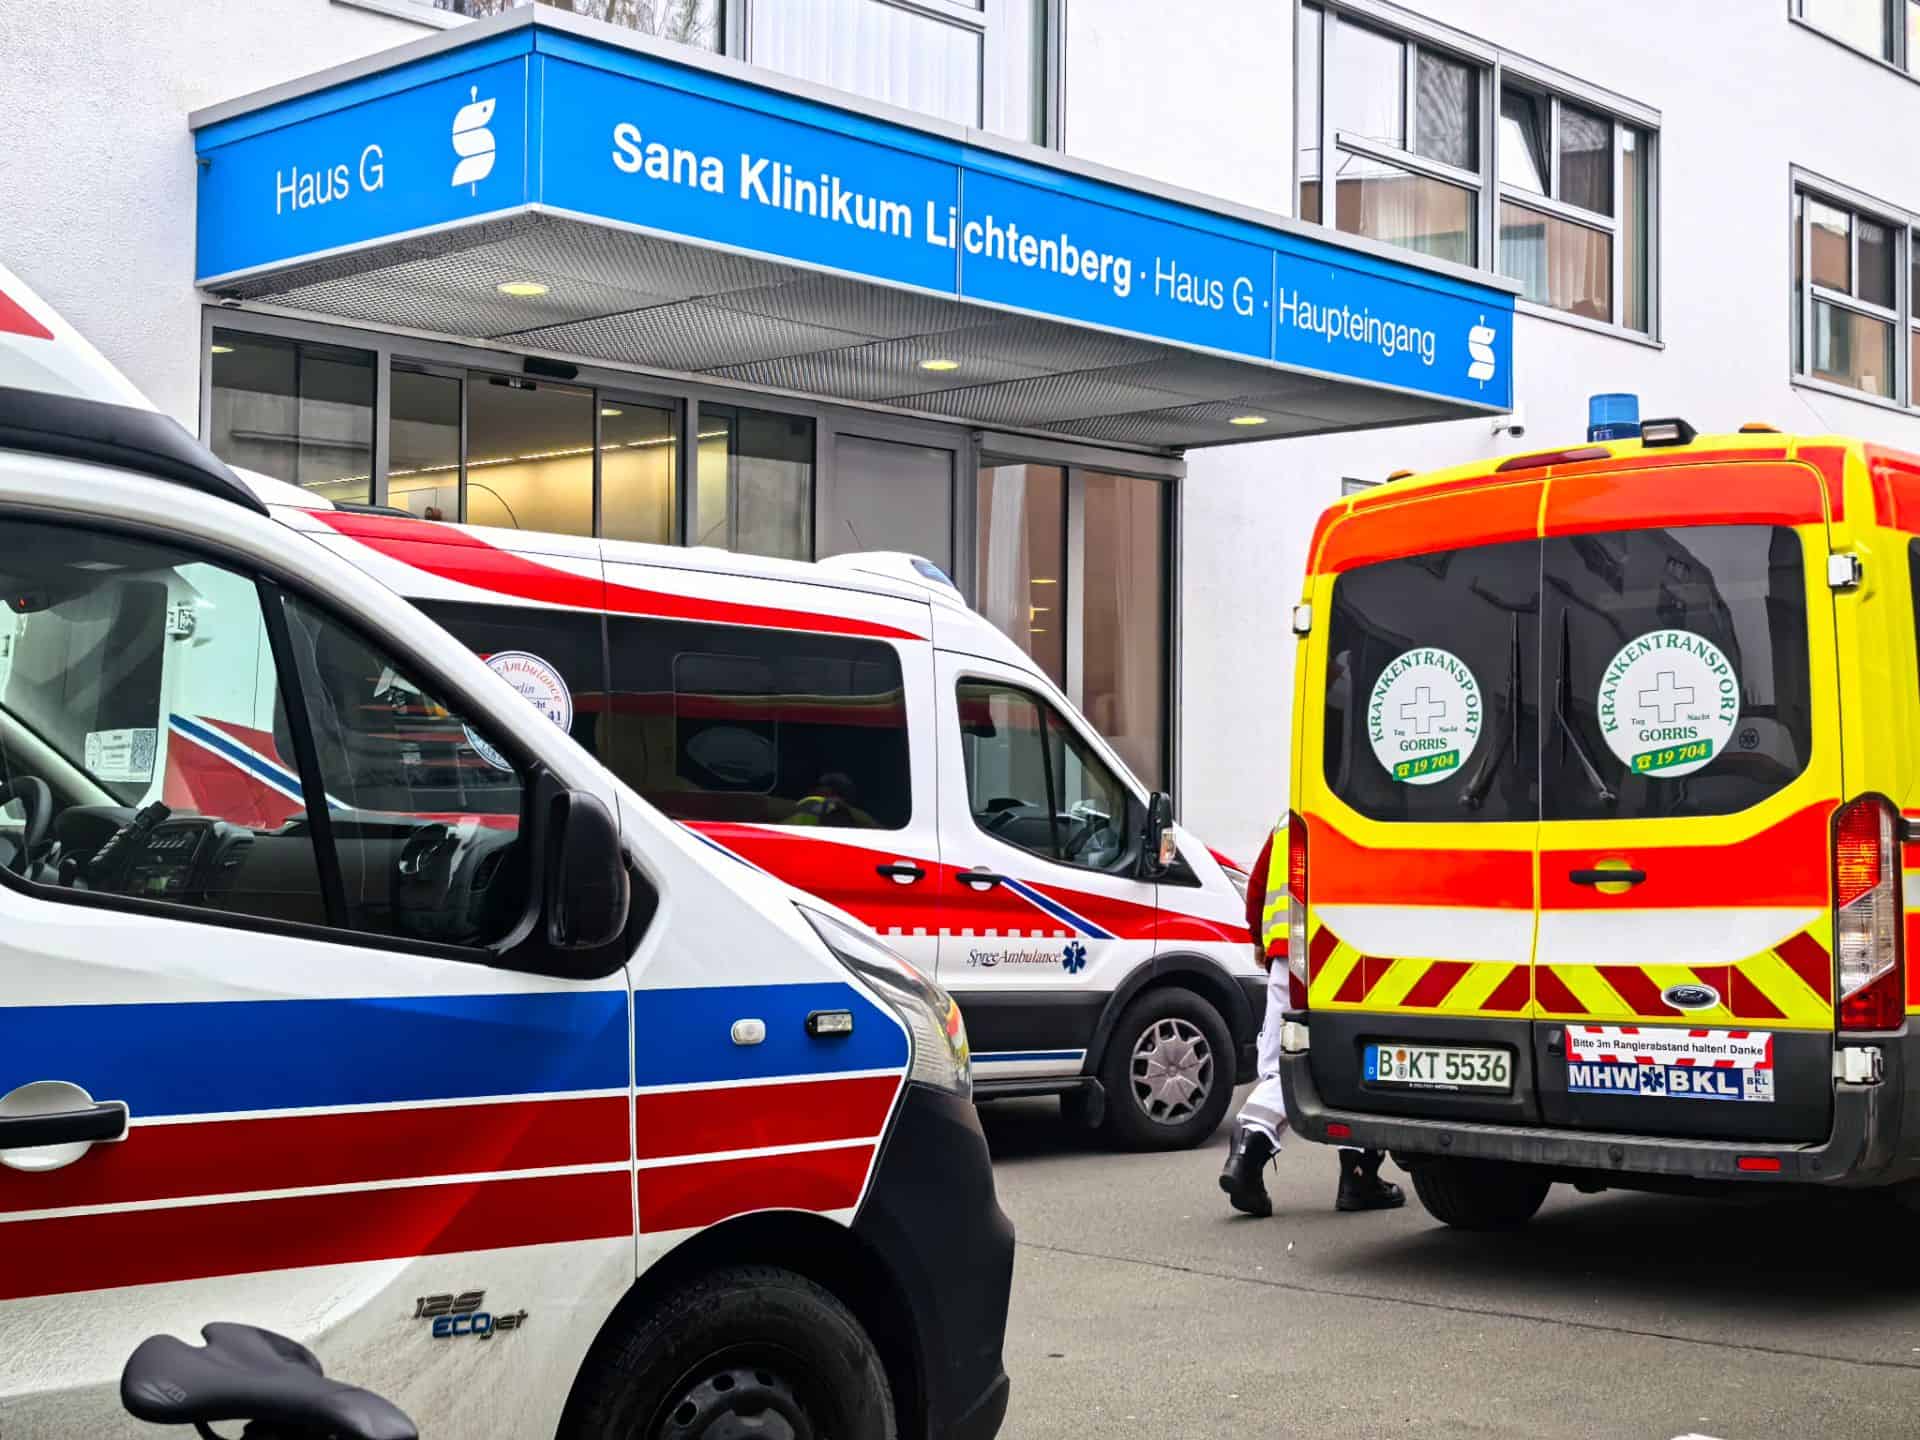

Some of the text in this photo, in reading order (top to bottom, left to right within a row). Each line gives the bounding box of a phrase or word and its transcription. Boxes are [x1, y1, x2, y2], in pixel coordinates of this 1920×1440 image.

[276, 144, 384, 215] Haus G
[612, 122, 1436, 366] Sana Klinikum Lichtenberg Haus G Haupteingang
[1370, 651, 1479, 743] KRANKENTRANSPORT
[1601, 633, 1736, 733] KRANKENTRANSPORT
[1400, 738, 1447, 752] GORRIS
[1639, 726, 1698, 742] GORRIS
[1414, 753, 1454, 774] 19 704
[1656, 743, 1706, 766] 19 704
[1573, 1038, 1763, 1056] Bitte 3m Rangierabstand halten! Danke
[1379, 1050, 1393, 1077] B
[1409, 1051, 1440, 1079] KT
[1446, 1053, 1507, 1082] 5536
[1568, 1064, 1739, 1095] MHW BKL
